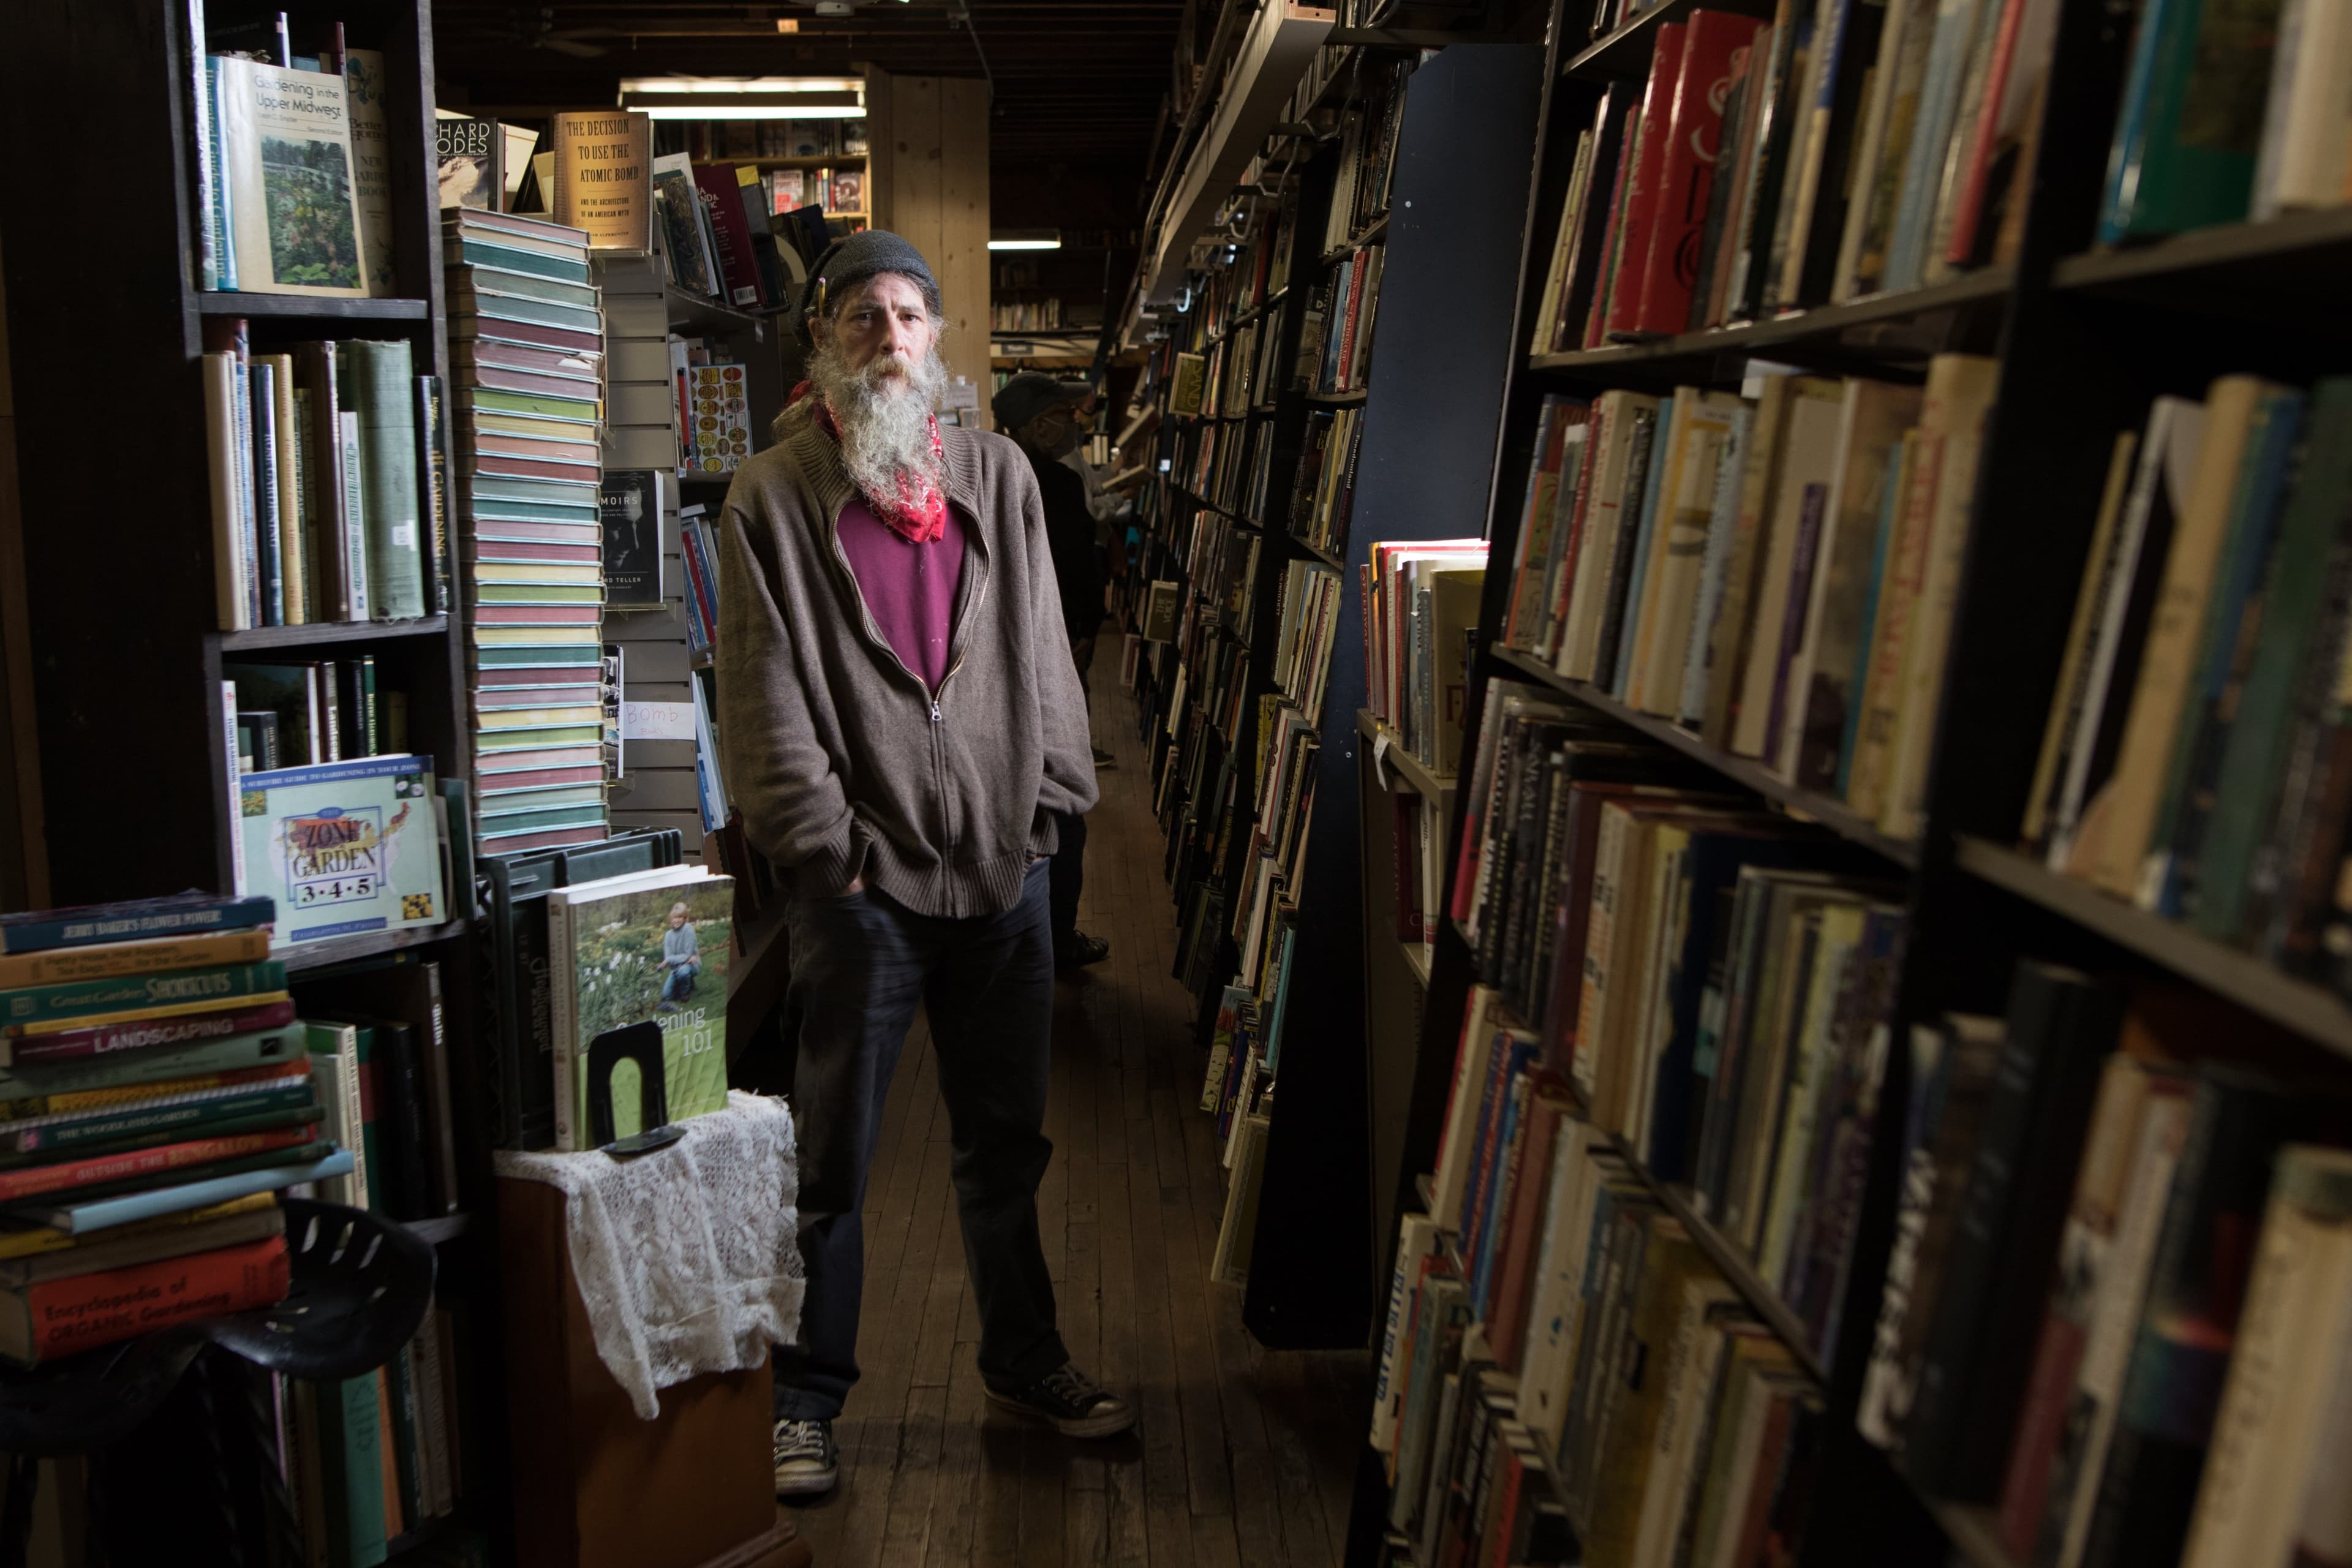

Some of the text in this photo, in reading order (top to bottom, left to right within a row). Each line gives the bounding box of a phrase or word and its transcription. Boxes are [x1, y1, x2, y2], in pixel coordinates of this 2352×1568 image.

[255, 75, 339, 99] Gardening in the
[256, 93, 341, 119] Upper Midwest
[567, 118, 629, 137] THE DECISION
[578, 143, 629, 160] TO USE THE
[580, 166, 639, 183] ATOMIC BOMB
[600, 197, 629, 205] ARCHITECTURE
[265, 468, 275, 548] GARDENING
[431, 470, 447, 558] GARDENING
[306, 820, 360, 848] ZONE
[293, 846, 375, 878] GARDEN
[50, 972, 232, 1008] Great Garden SHORTCUTS
[94, 1018, 235, 1054] LANDSCAPING
[682, 1028, 714, 1058] 101
[77, 1135, 264, 1181] OUTSIDE THE BUNGALOW
[45, 1276, 187, 1321] Encyclopedia of
[48, 1292, 231, 1343] ORGANIC Gardening
